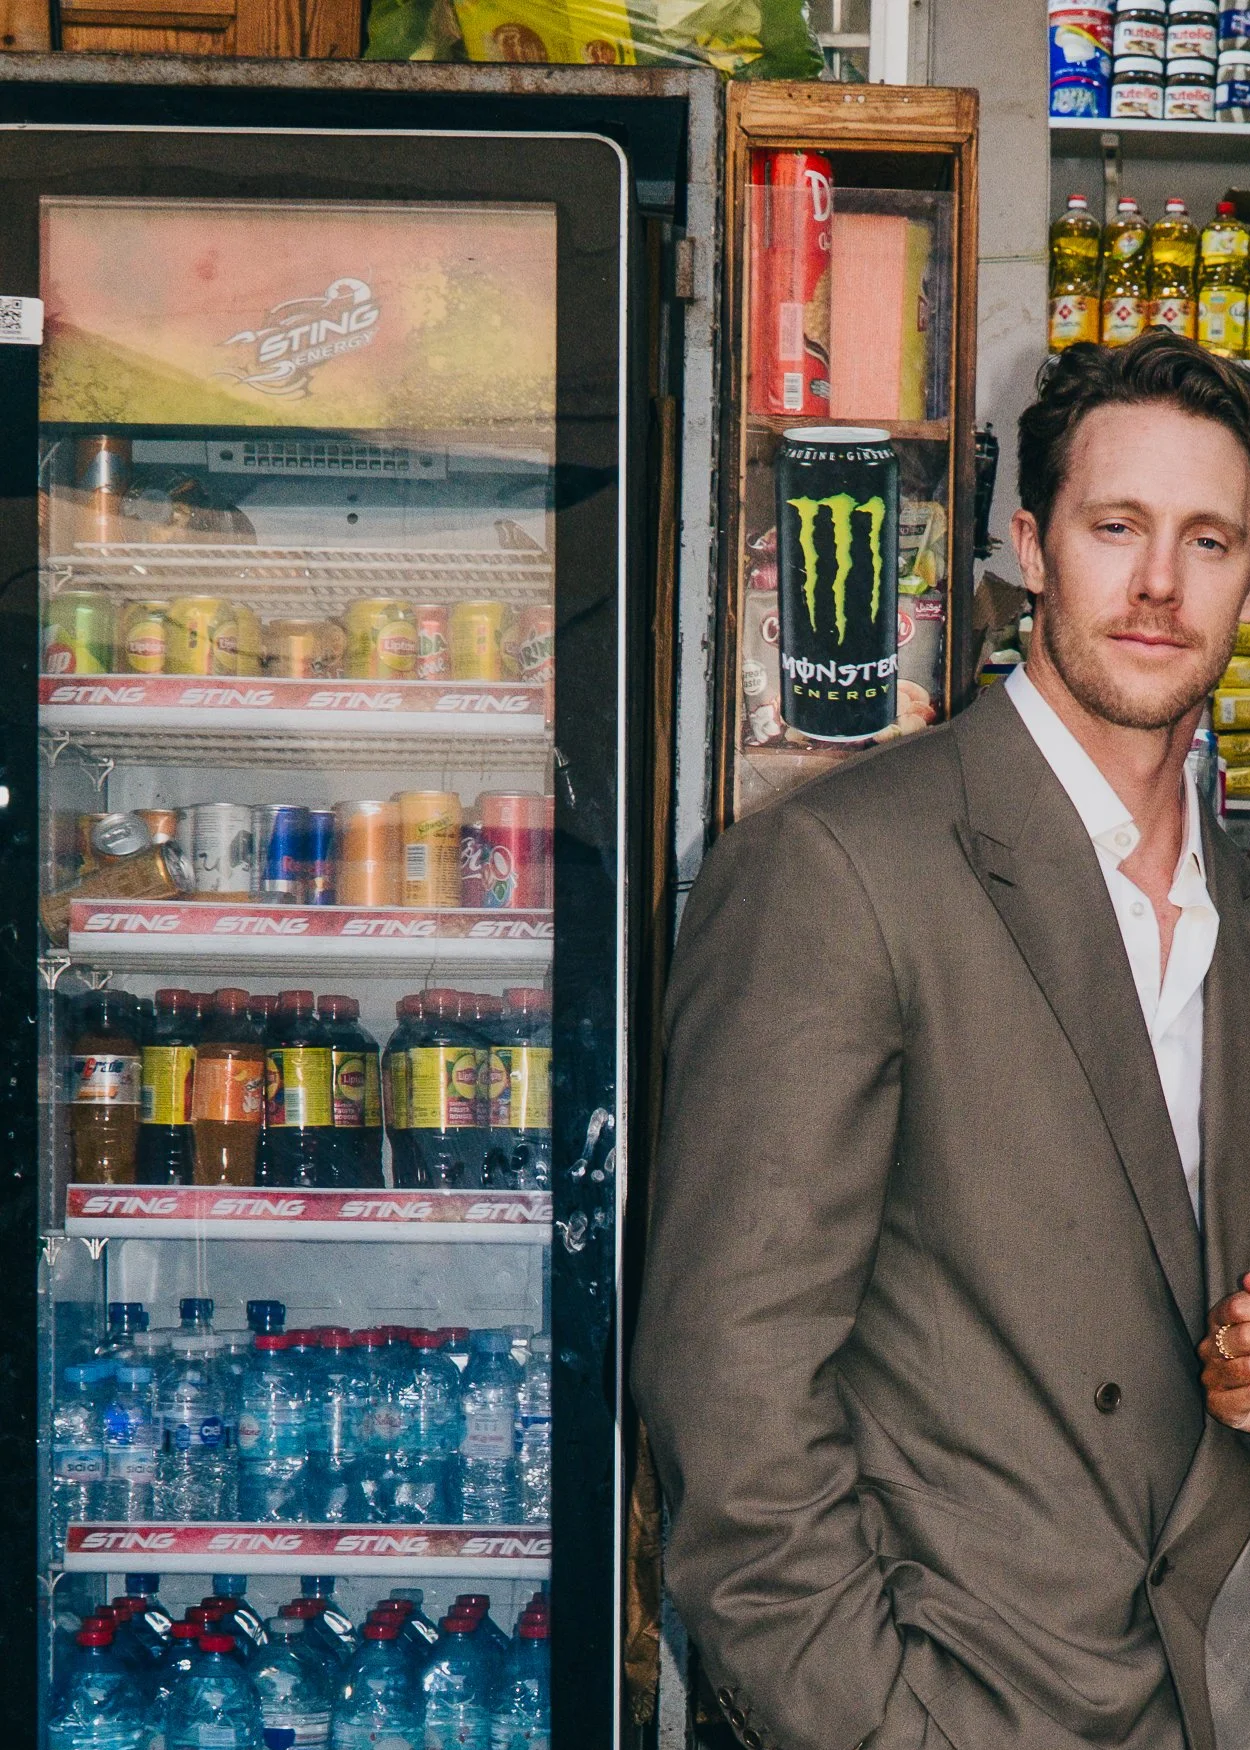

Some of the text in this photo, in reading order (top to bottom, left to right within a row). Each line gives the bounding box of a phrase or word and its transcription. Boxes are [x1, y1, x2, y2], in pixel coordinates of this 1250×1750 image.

[1116, 87, 1159, 100] nutella
[259, 303, 380, 363] STING
[294, 326, 381, 366] ENERGY
[50, 686, 146, 703] STING
[180, 688, 275, 706] STING
[305, 691, 402, 710] STING
[793, 684, 890, 700] ENERGY
[435, 694, 531, 712] STING
[84, 913, 180, 931] STING
[213, 916, 309, 934] STING
[340, 919, 438, 937] STING
[82, 1196, 178, 1215] STING
[209, 1199, 305, 1217] STING
[337, 1201, 433, 1219] STING
[80, 1533, 175, 1549] STING
[207, 1534, 303, 1552] STING
[334, 1536, 430, 1554] STING
[461, 1538, 552, 1556] STING
